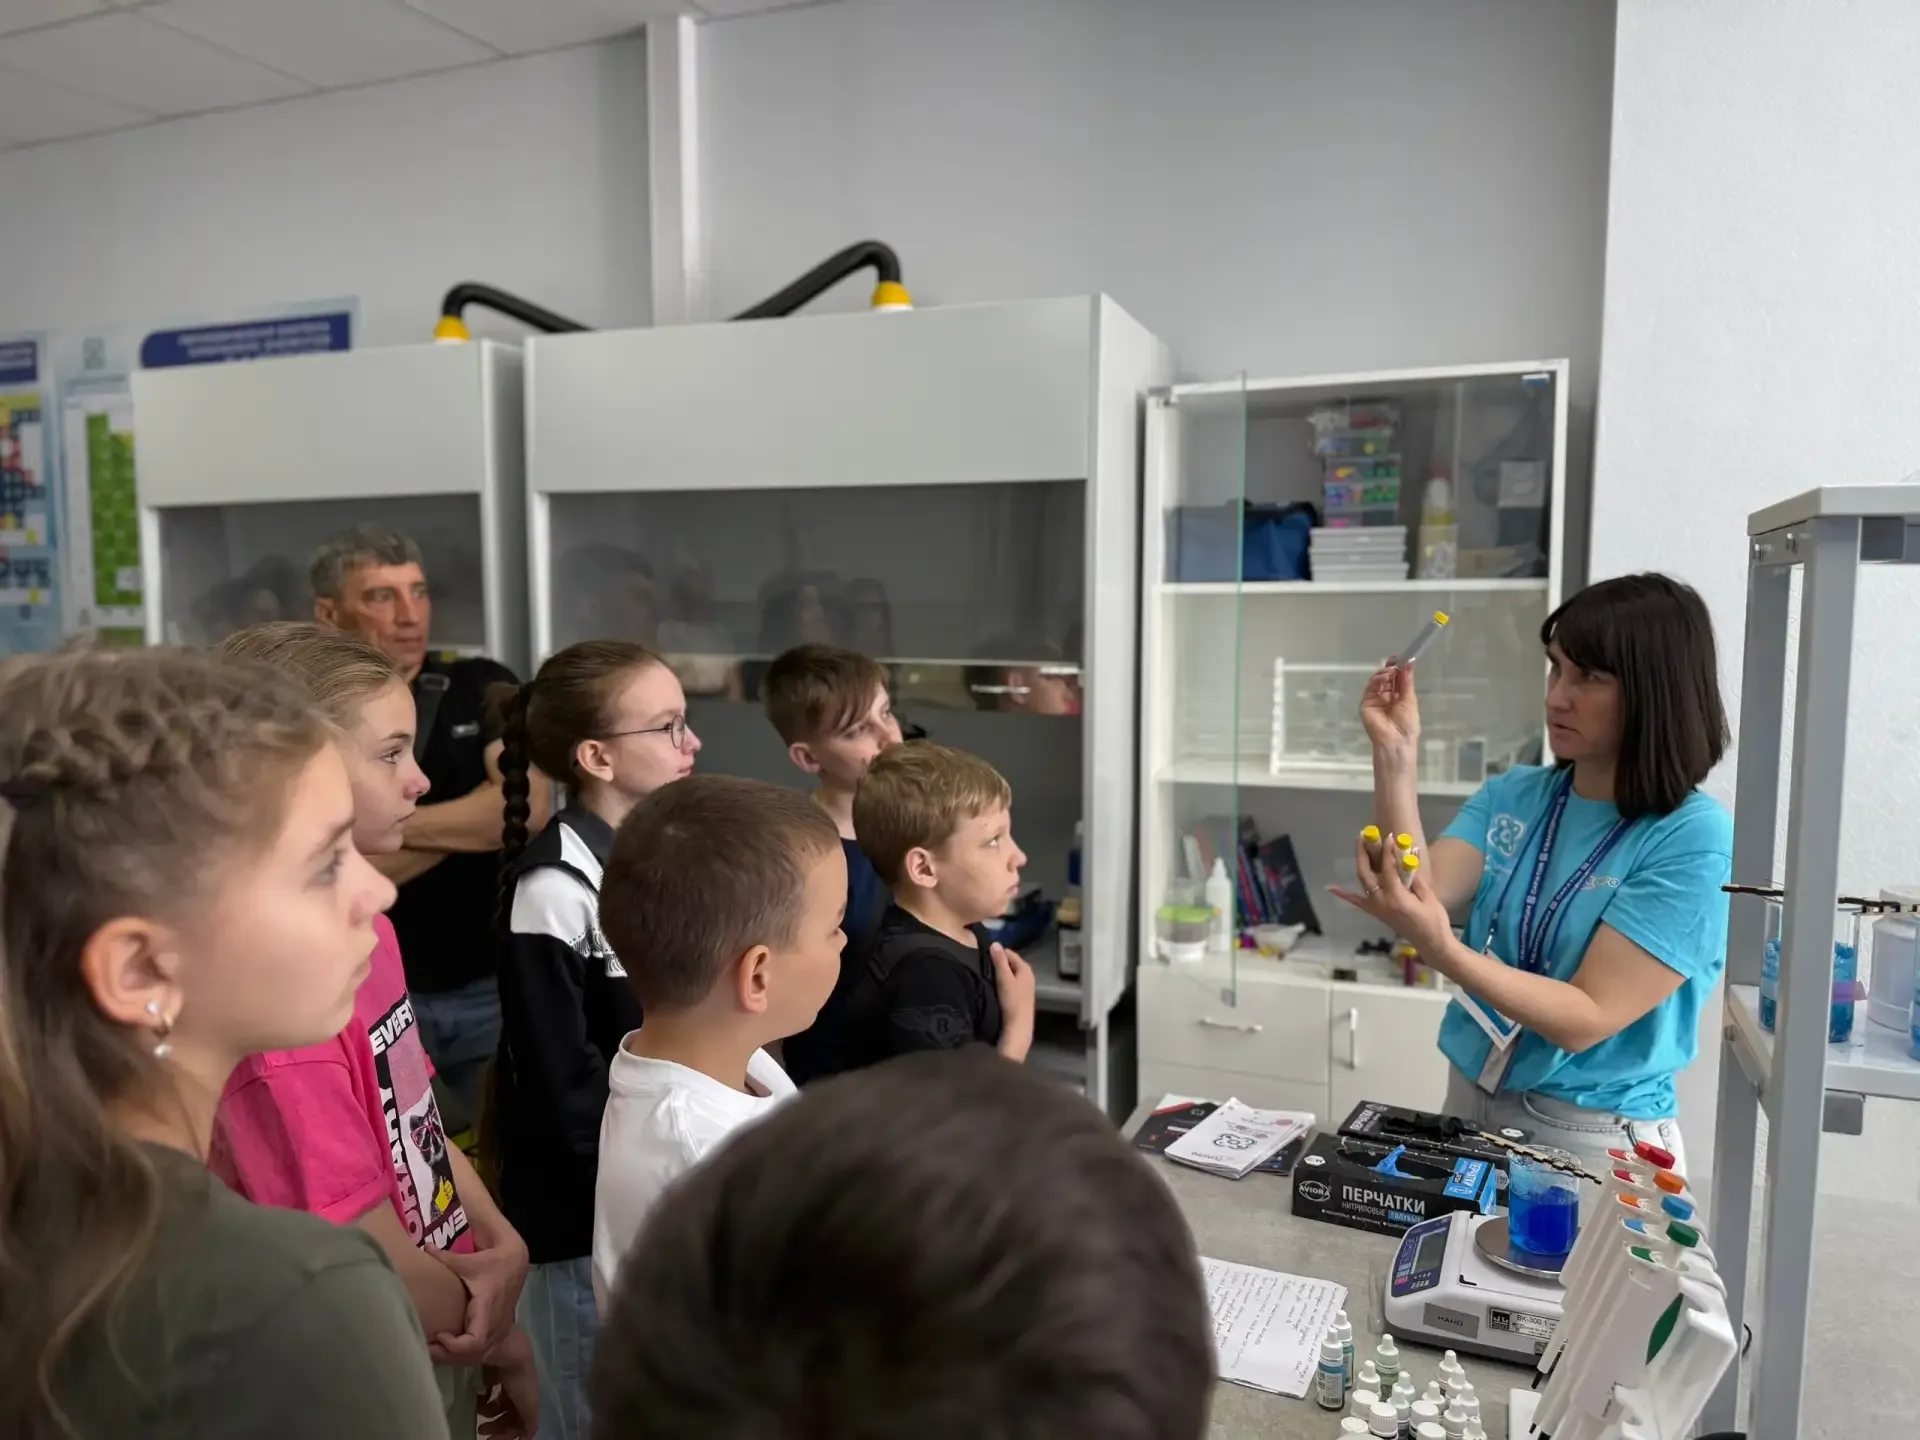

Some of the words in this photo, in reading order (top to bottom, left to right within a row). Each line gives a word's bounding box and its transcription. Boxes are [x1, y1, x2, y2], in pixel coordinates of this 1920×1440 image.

[369, 998, 416, 1056] EVER
[1299, 1185, 1330, 1197] AVIORA
[1342, 1185, 1425, 1215] ПЕРЧАТКИ
[1342, 1201, 1387, 1217] НИТРИЛОВЫЕ
